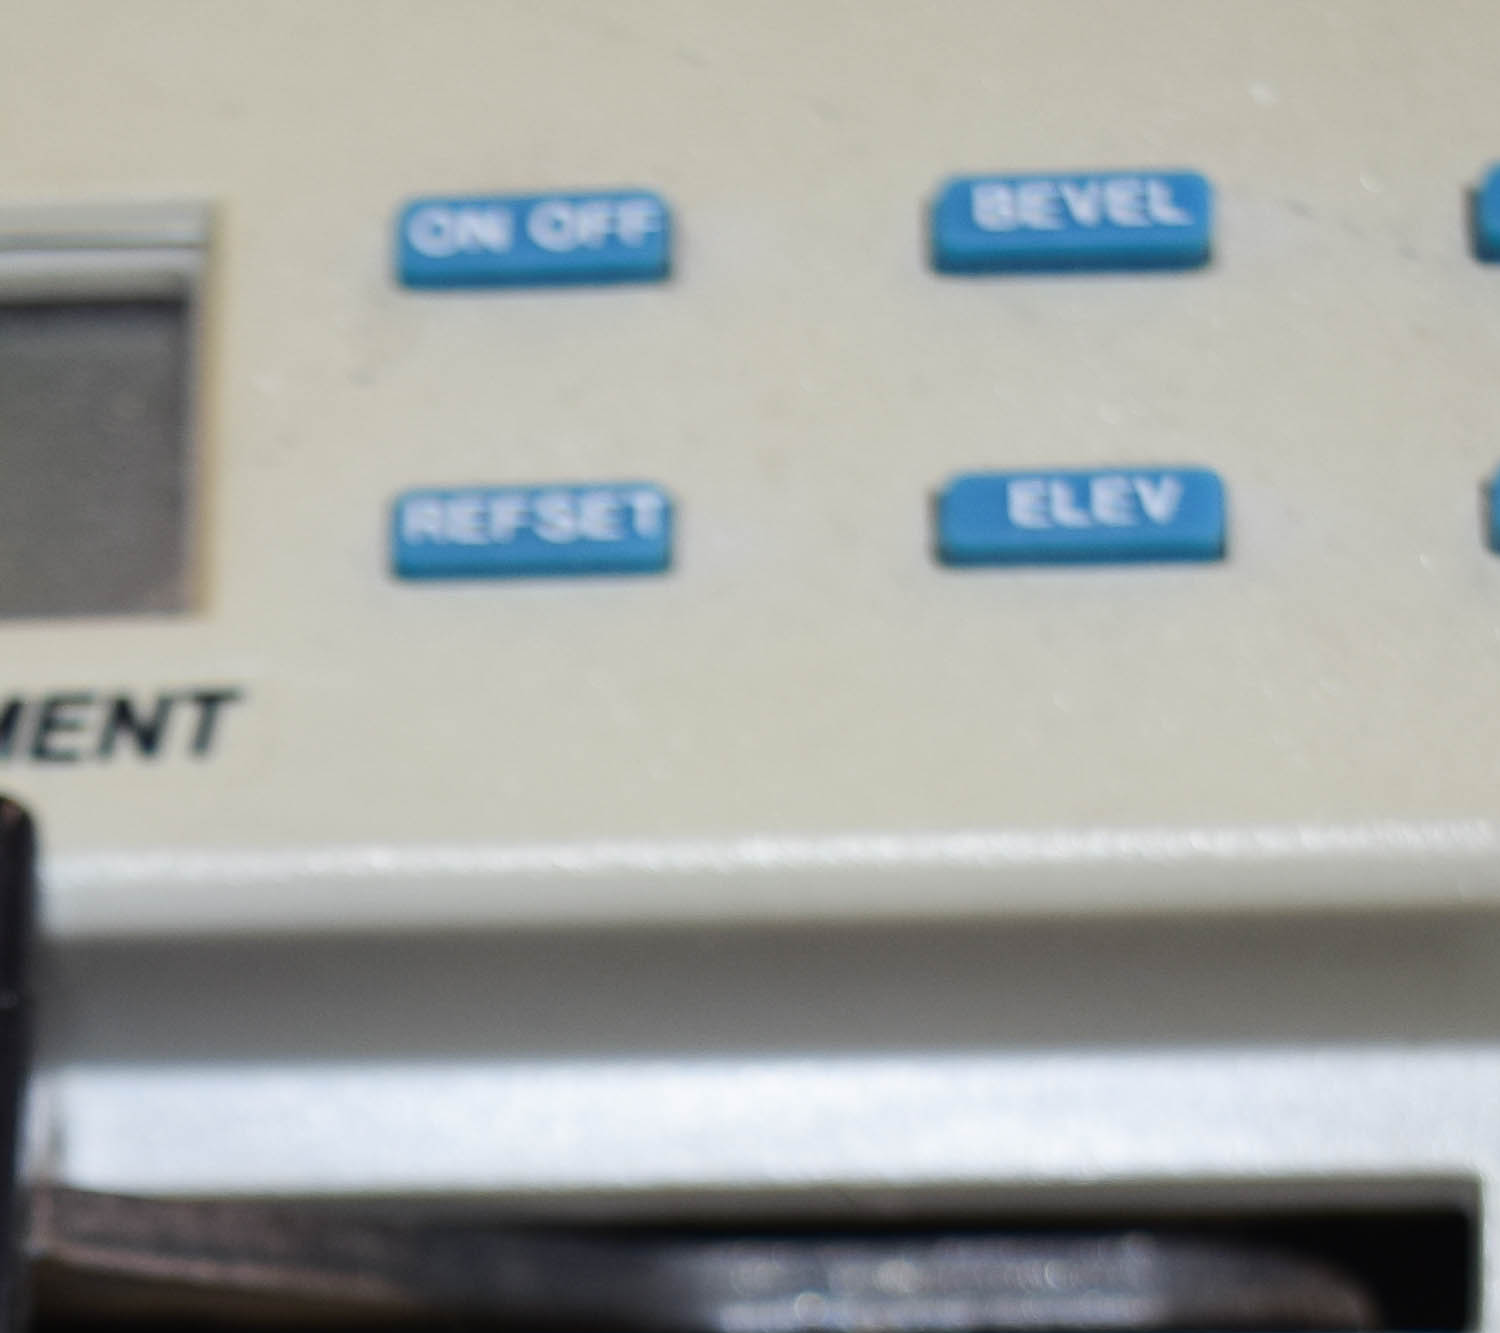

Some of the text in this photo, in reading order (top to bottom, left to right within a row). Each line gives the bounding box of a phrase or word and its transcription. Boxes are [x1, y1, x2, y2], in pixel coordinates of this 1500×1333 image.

[405, 196, 662, 258] ON OFF
[970, 178, 1193, 232] BEVEL
[402, 488, 664, 546] REFSET
[1006, 474, 1182, 530] ELEV
